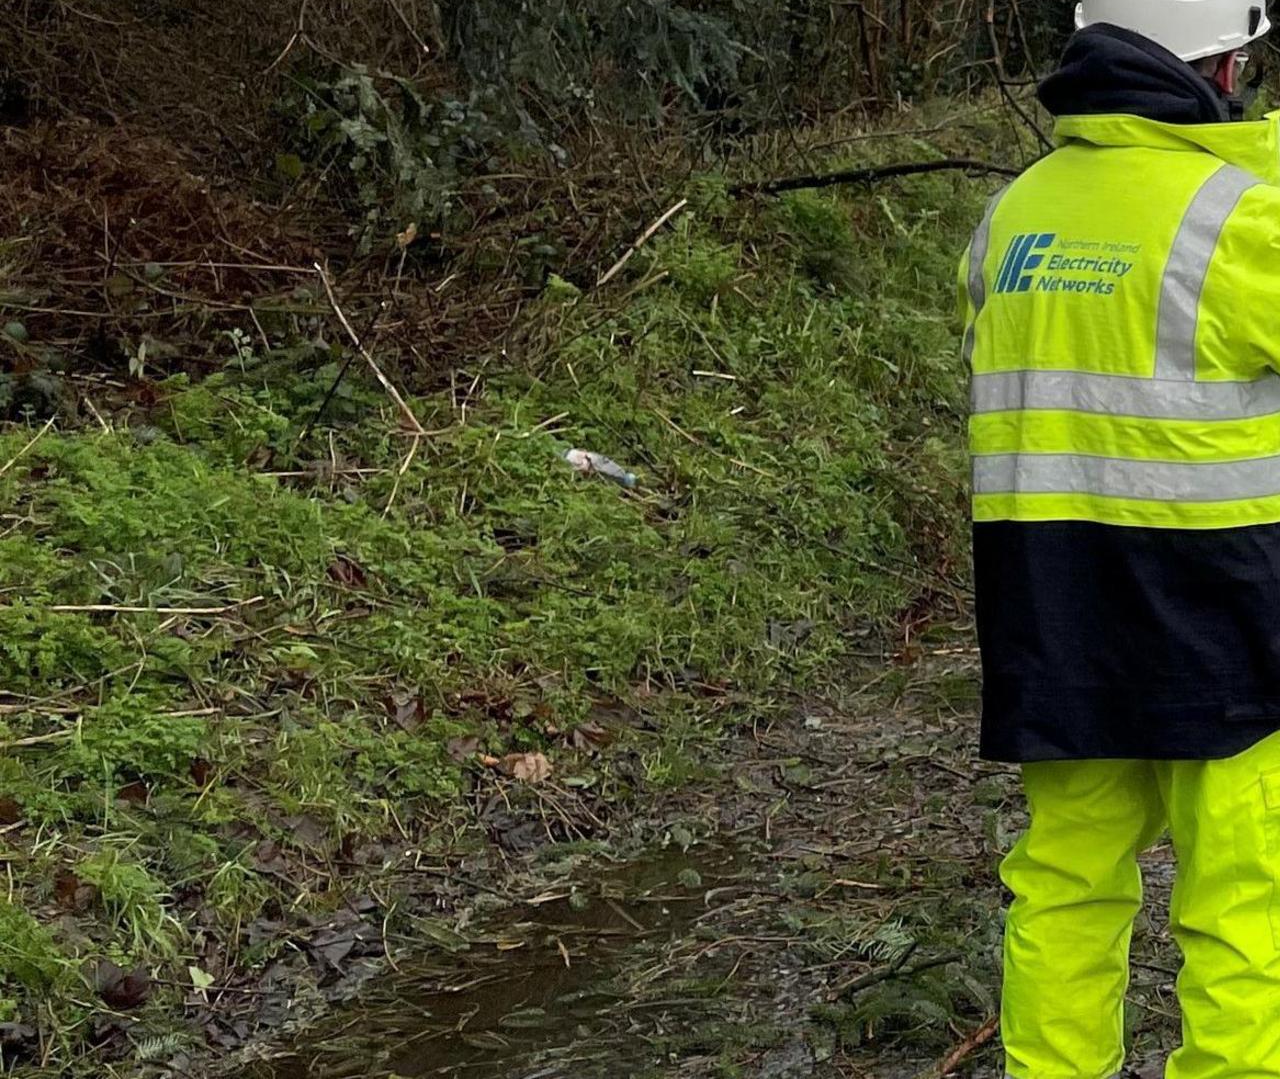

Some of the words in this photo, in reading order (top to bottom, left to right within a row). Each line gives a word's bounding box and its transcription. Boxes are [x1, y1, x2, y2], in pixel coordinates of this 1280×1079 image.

[1058, 239, 1100, 250] Northern
[1102, 242, 1141, 253] Ireland
[1047, 254, 1133, 277] Electricity
[1036, 276, 1114, 295] Networks
